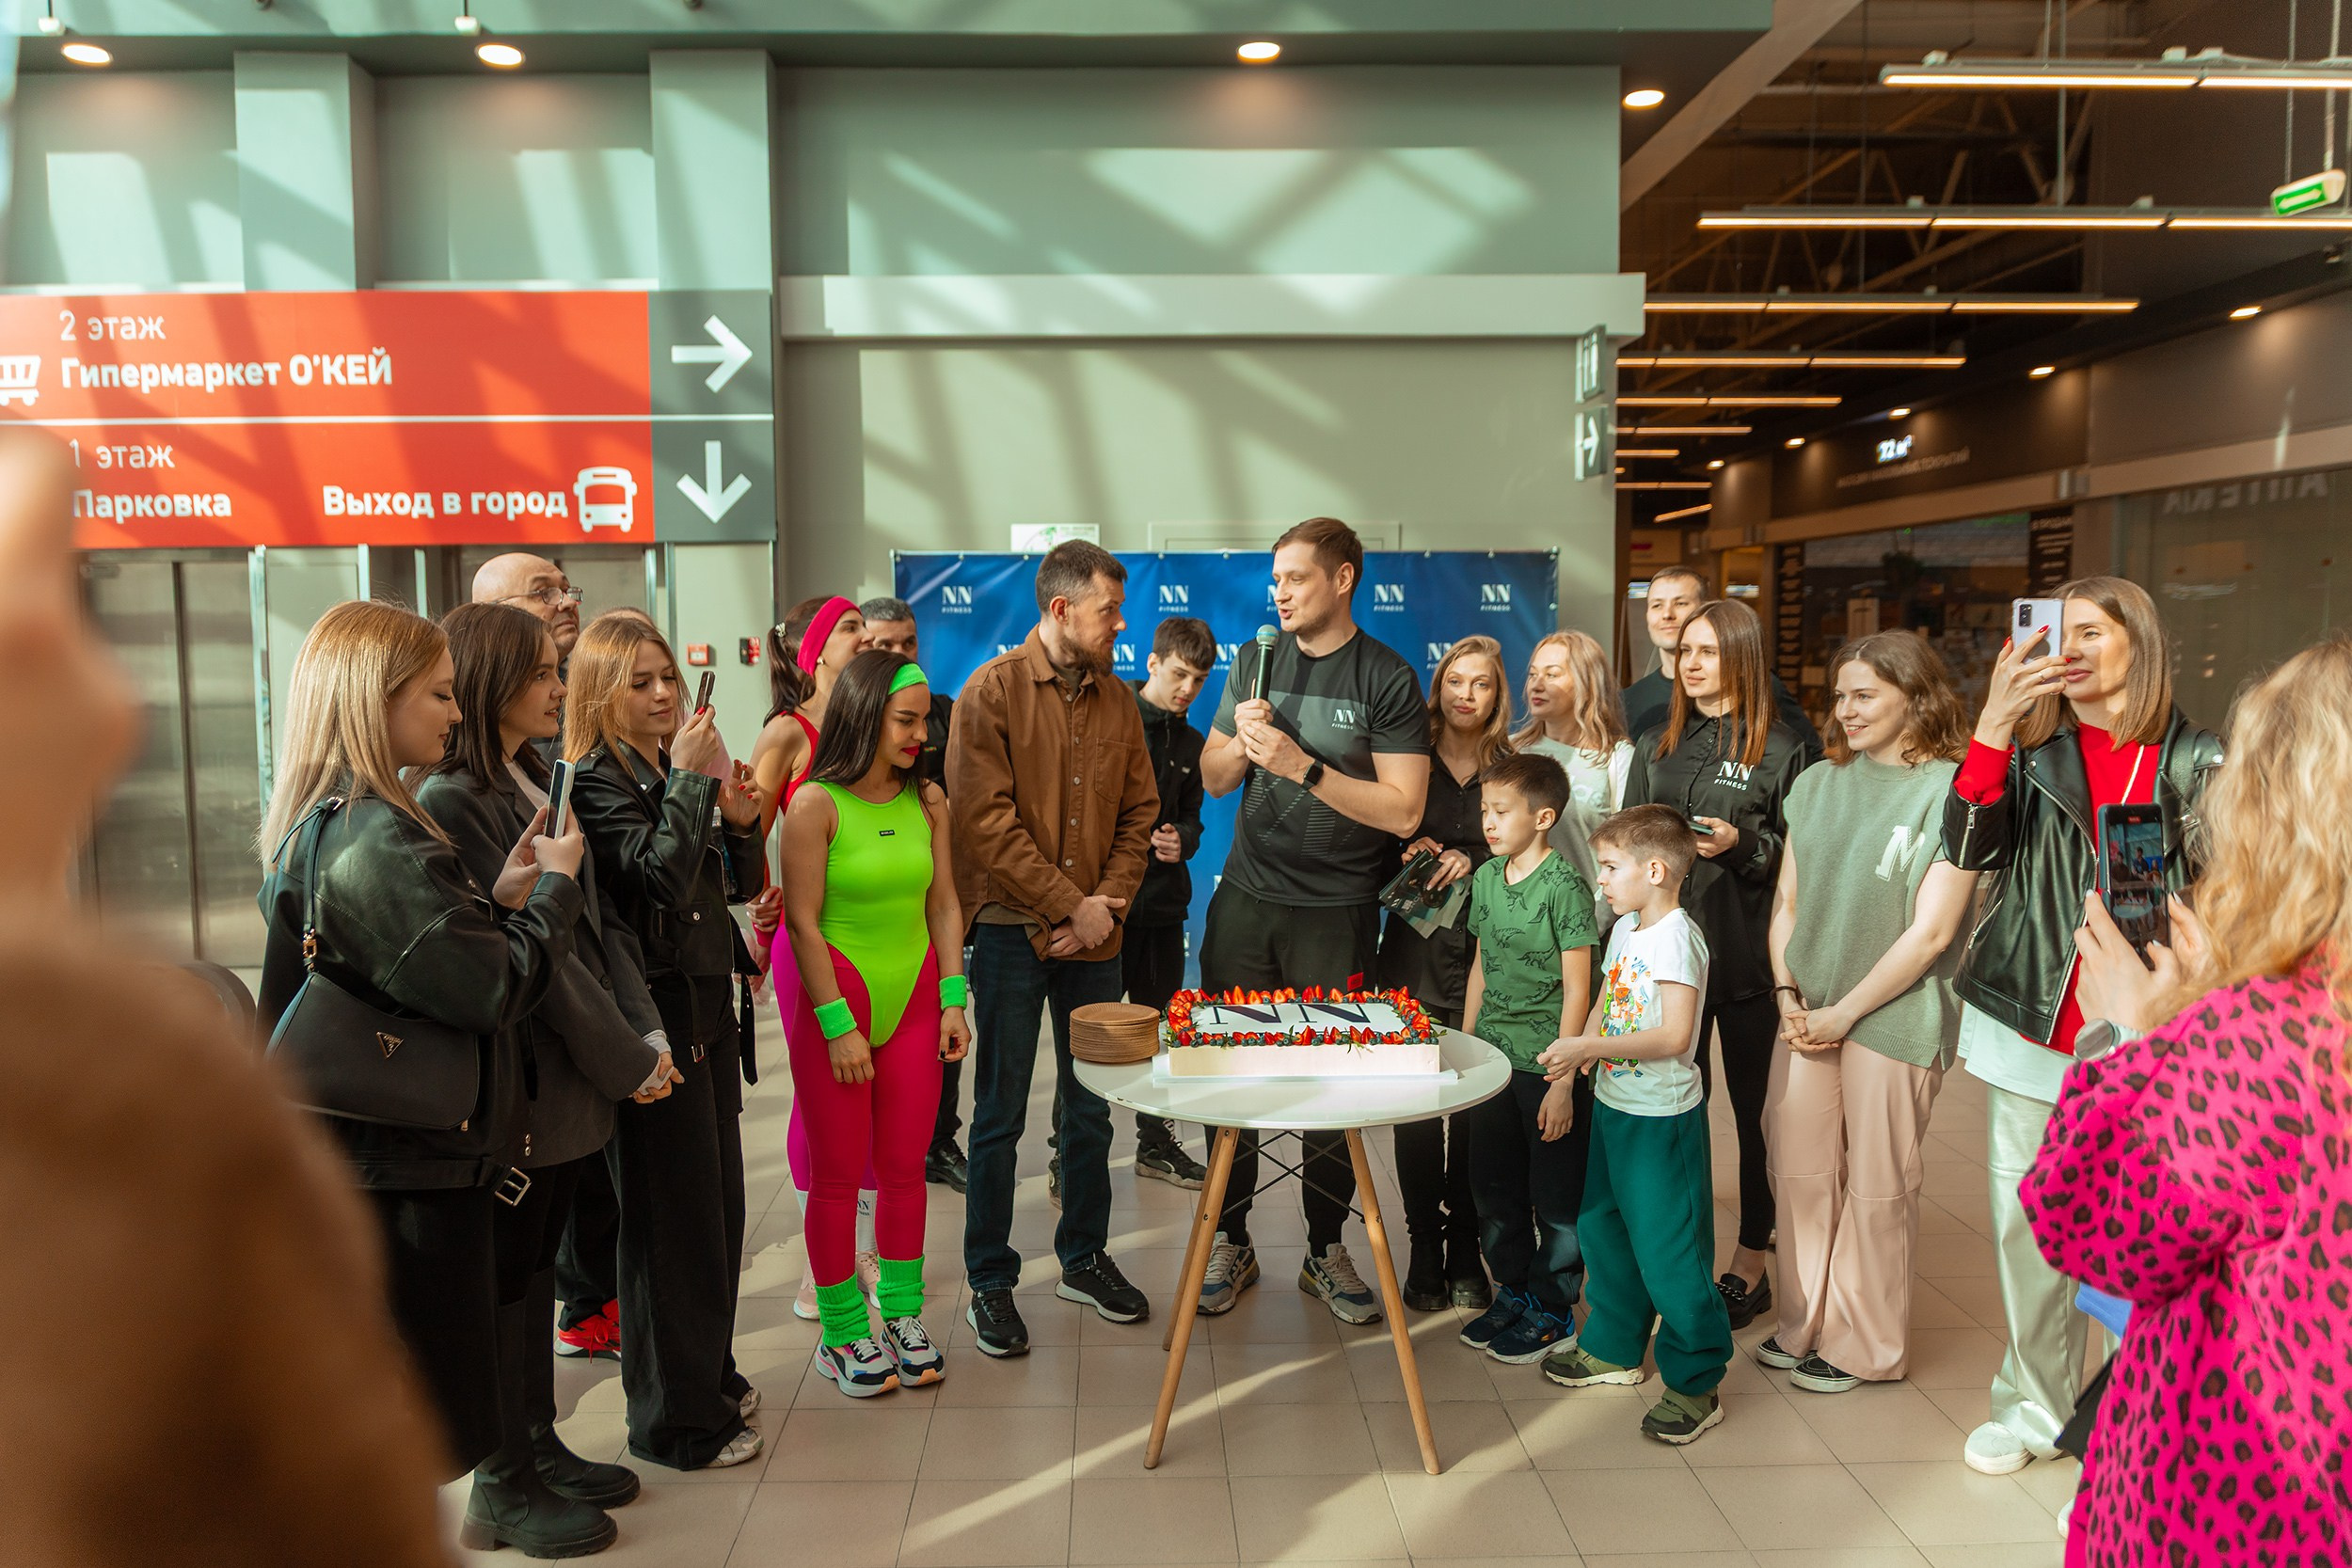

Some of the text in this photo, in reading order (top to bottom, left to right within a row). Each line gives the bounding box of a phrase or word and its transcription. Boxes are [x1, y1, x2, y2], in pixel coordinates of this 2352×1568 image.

[59, 309, 167, 341] 2 этаж
[60, 346, 392, 394] Гипермаркет О'КЕЙ
[69, 438, 175, 468] 1 этаж
[73, 488, 231, 524] Парковка
[323, 485, 569, 521] Выход в город
[942, 586, 972, 605] NN
[1159, 585, 1189, 604] NN
[1374, 584, 1405, 603] NN
[1481, 584, 1511, 603] NN
[1333, 709, 1355, 723] NN
[1717, 761, 1755, 782] NN
[1714, 779, 1748, 791] FITNESS
[1875, 825, 1926, 886] M
[1210, 1003, 1371, 1025] NN
